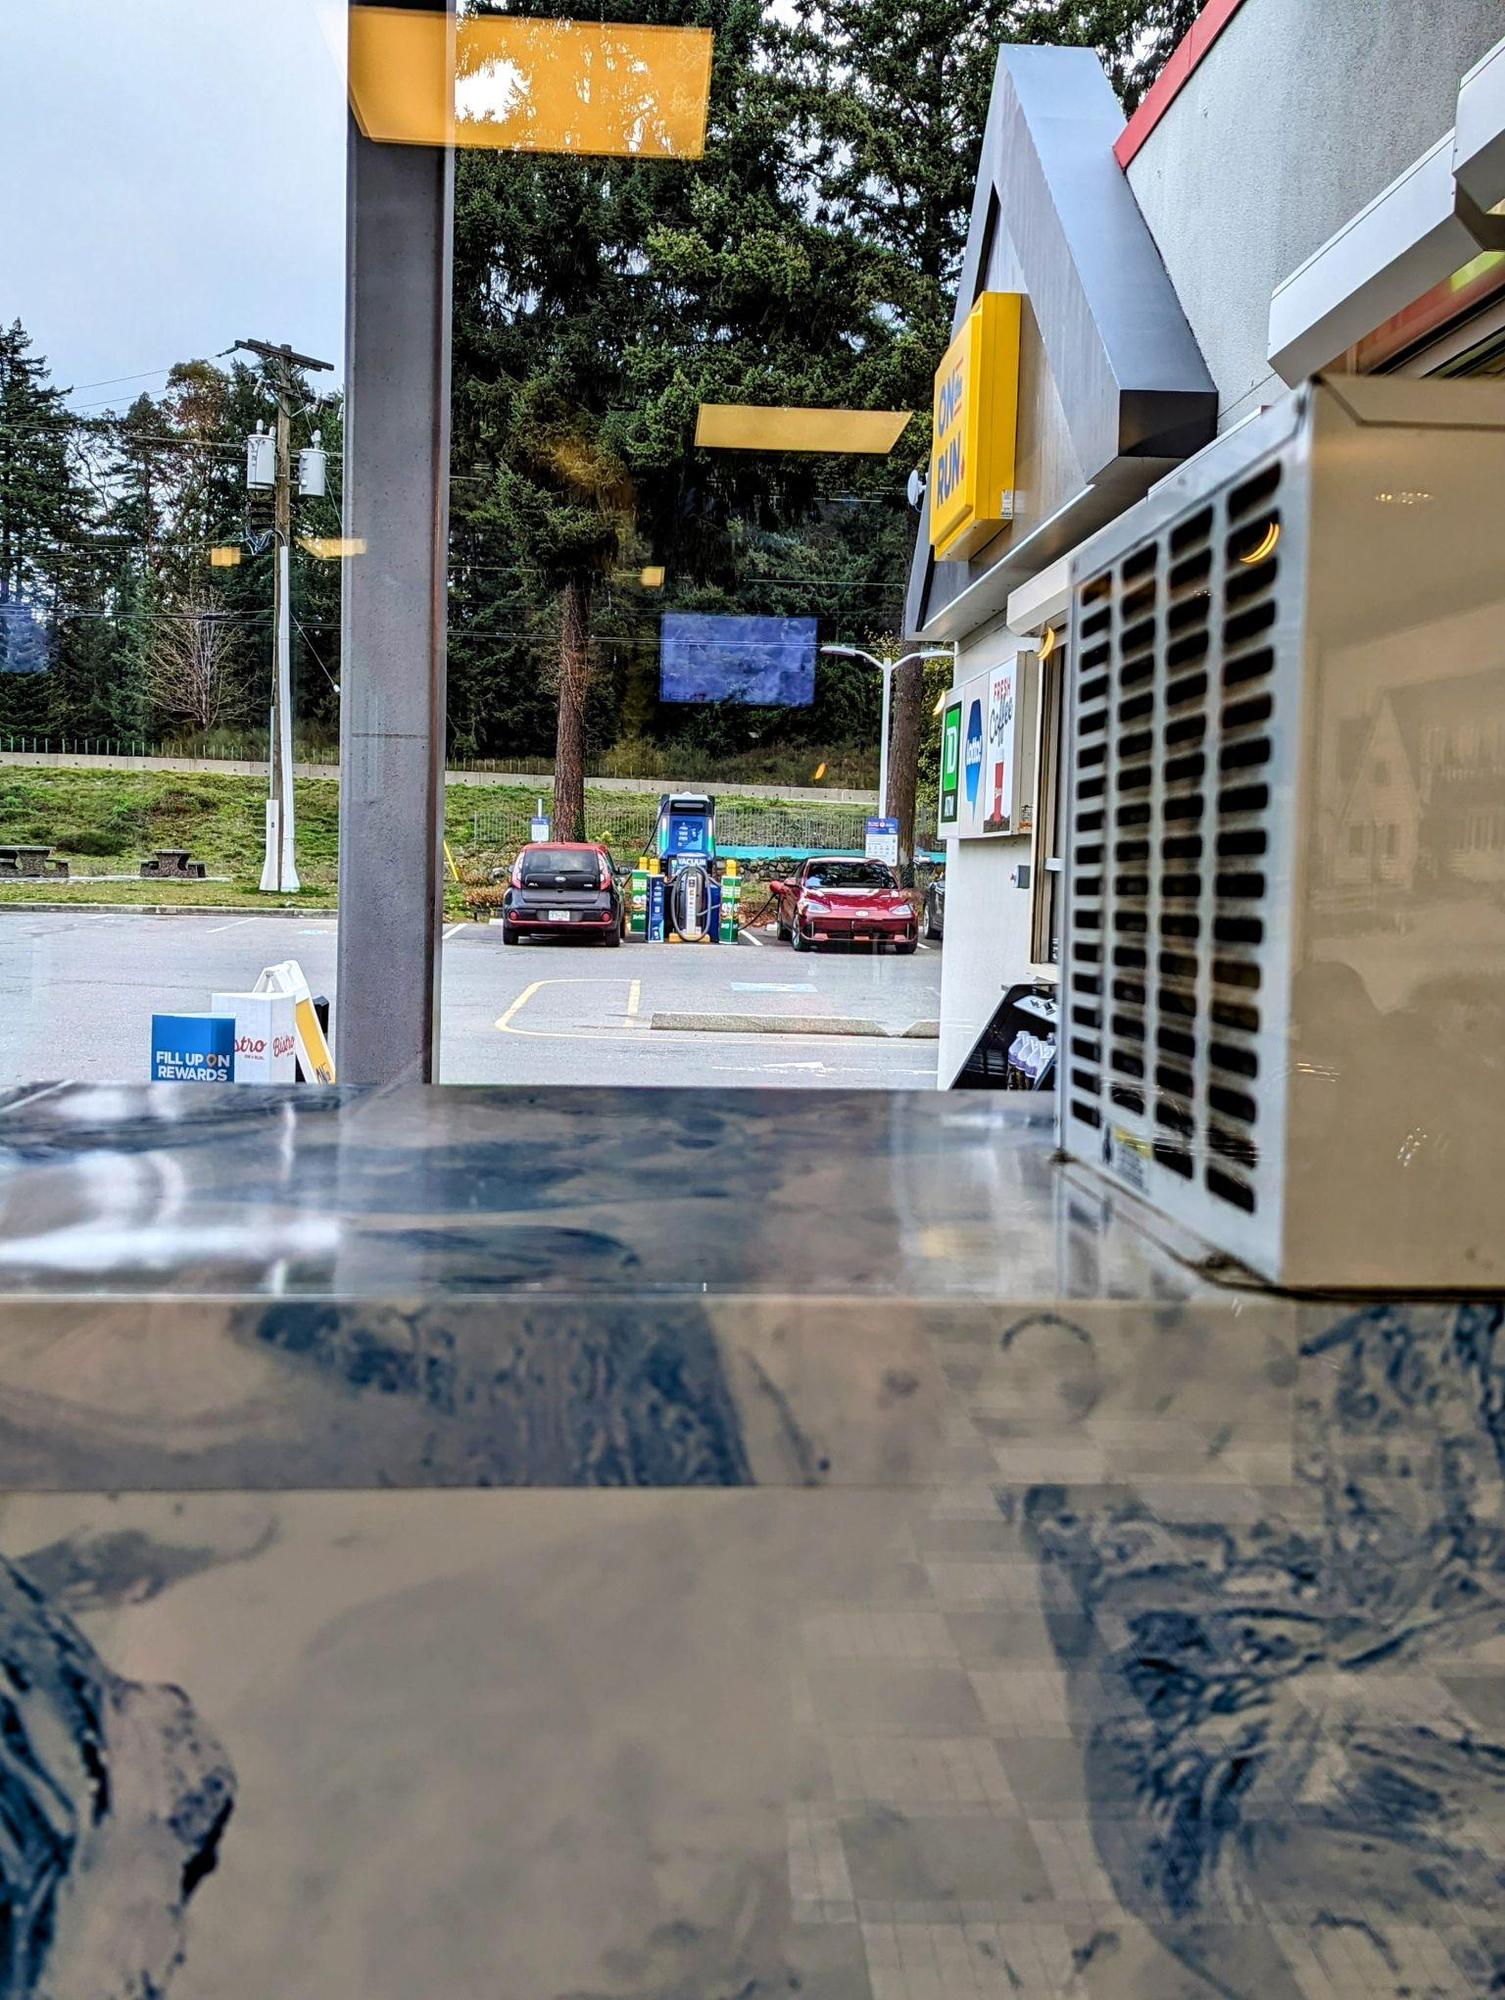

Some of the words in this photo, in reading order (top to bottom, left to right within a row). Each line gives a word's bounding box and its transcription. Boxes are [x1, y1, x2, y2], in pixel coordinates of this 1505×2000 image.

[994, 677, 1011, 702] FRESH
[989, 696, 1013, 748] Coffee
[234, 1036, 267, 1053] stro
[156, 1051, 183, 1065] FILL
[186, 1052, 204, 1066] UP
[206, 1053, 230, 1068] ON
[158, 1066, 228, 1082] REWARDS
